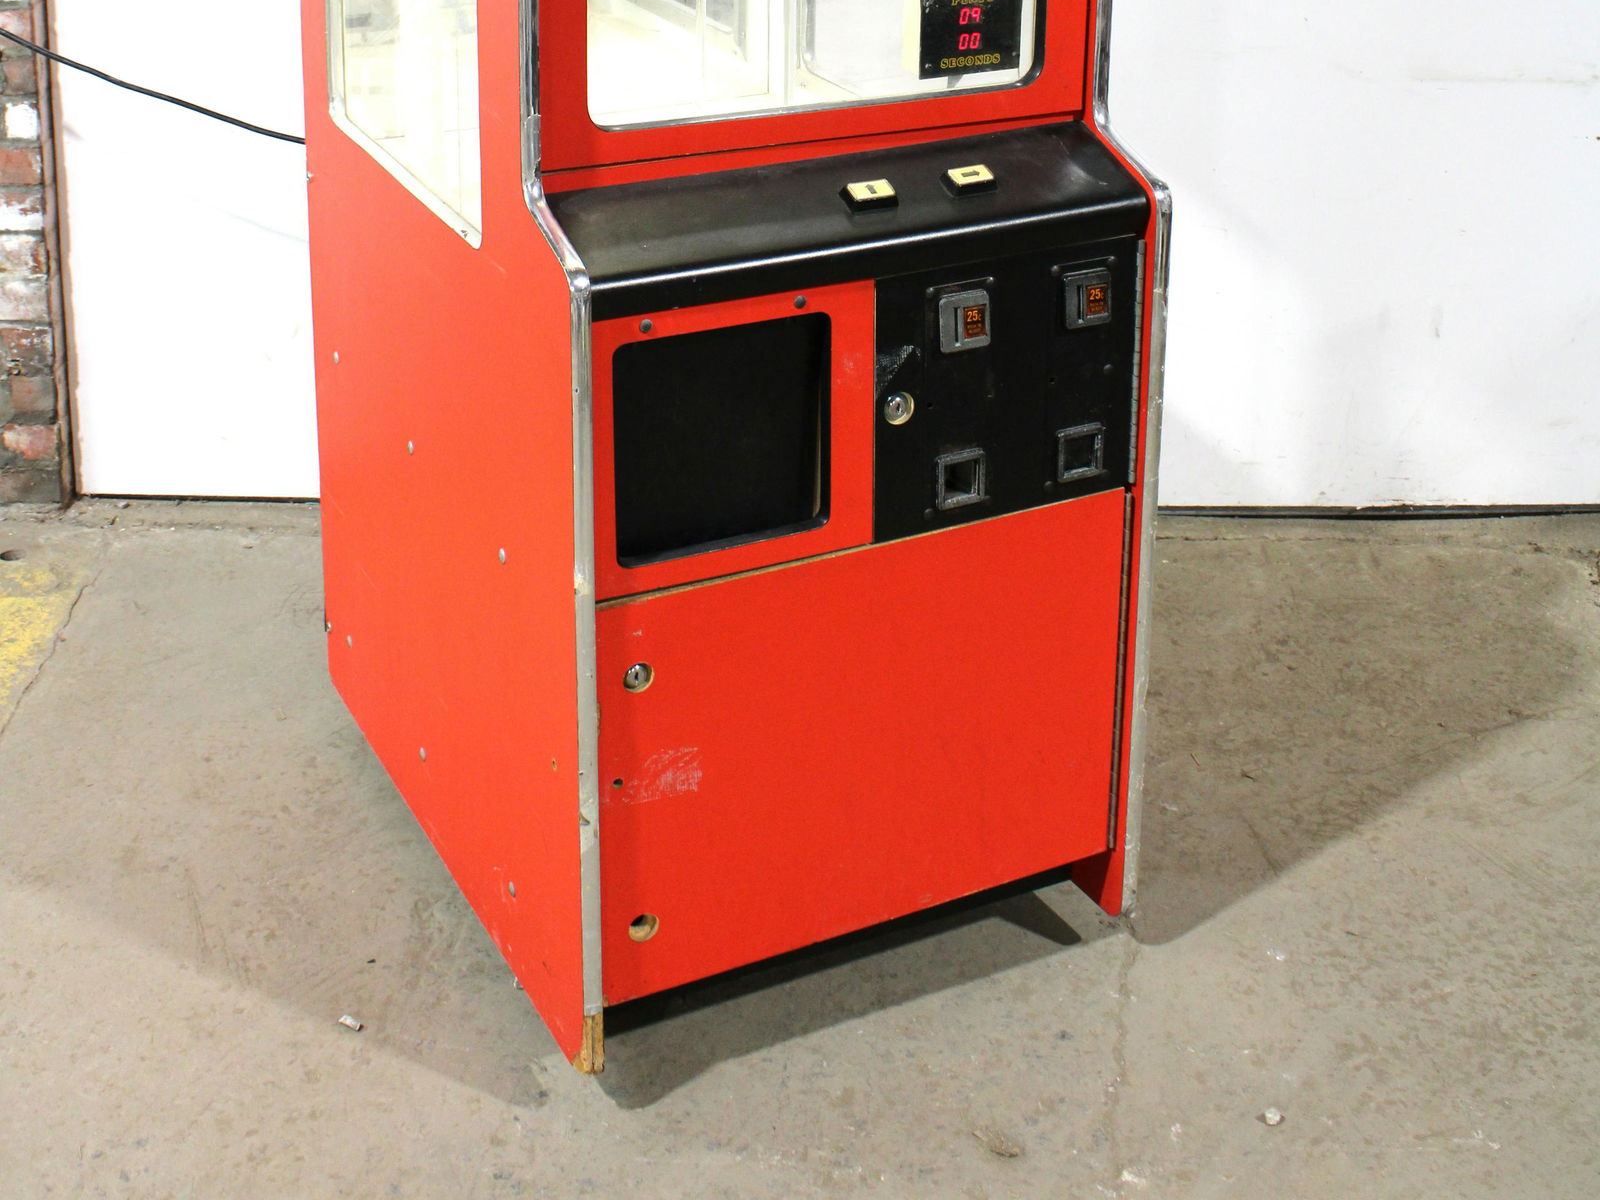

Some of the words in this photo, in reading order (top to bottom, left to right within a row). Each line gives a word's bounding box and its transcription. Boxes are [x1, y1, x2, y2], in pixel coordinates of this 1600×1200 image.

[959, 7, 981, 25] 09
[958, 32, 980, 50] 00
[940, 53, 1001, 69] SECONDS
